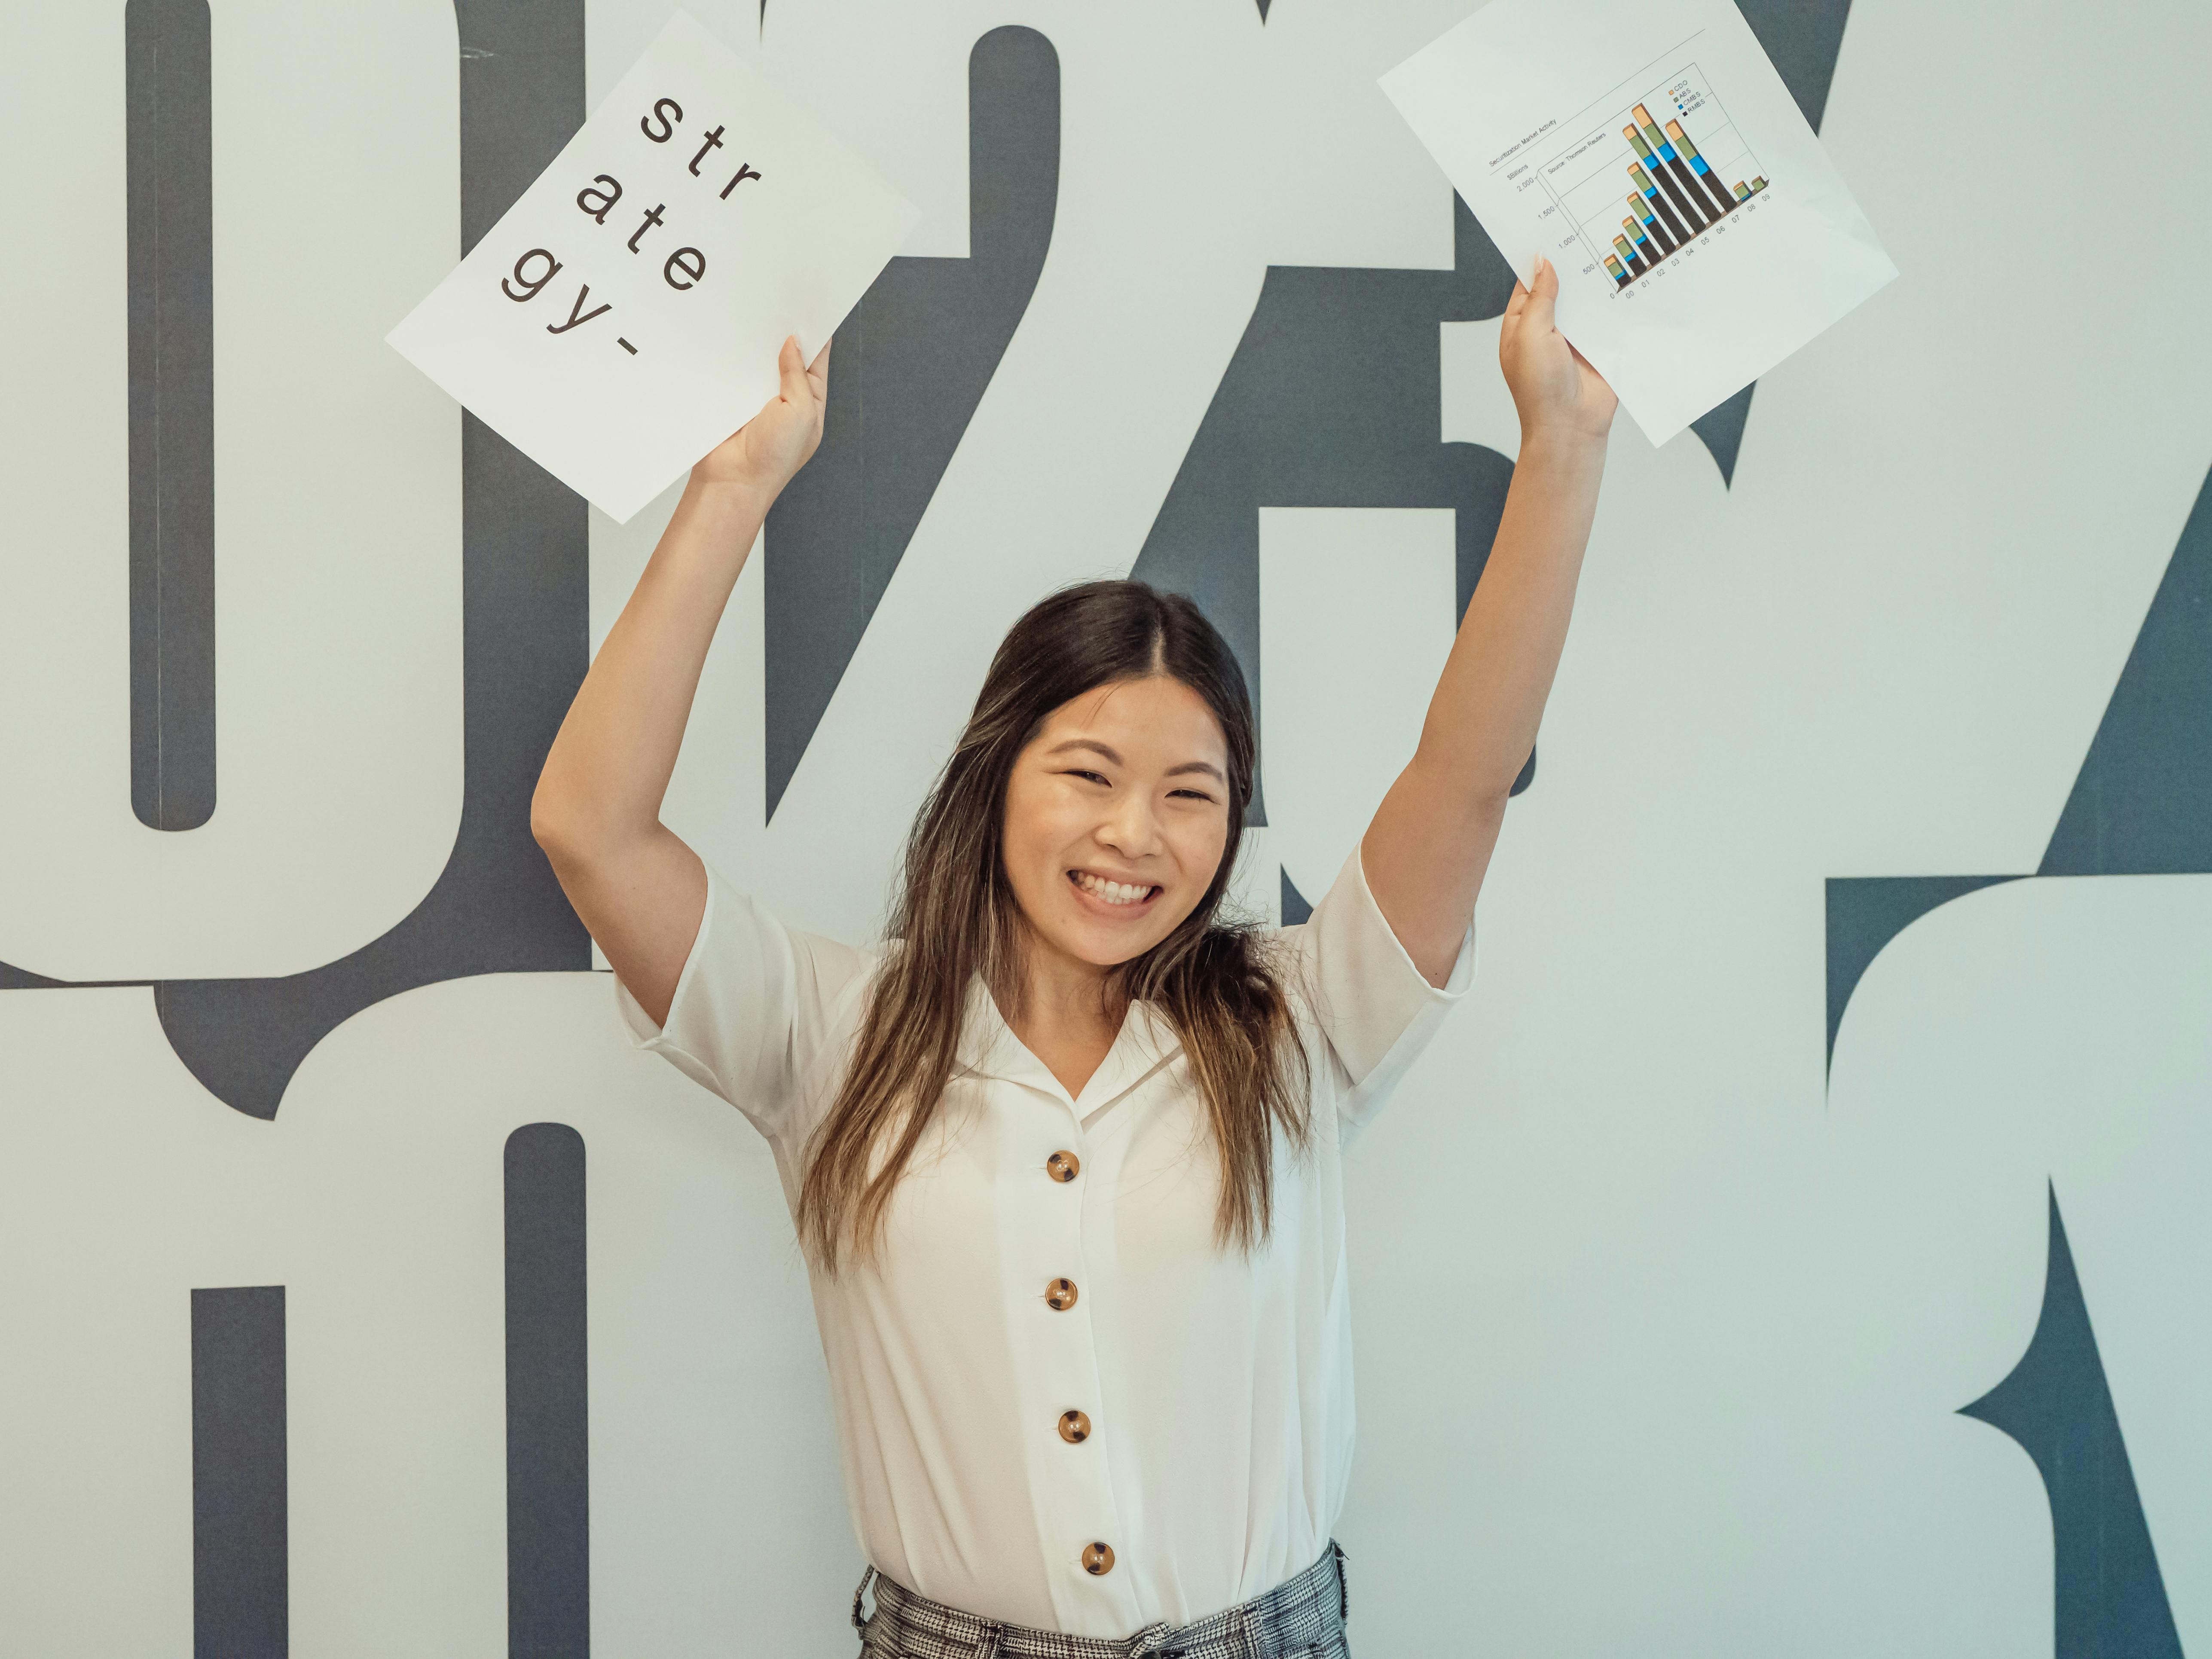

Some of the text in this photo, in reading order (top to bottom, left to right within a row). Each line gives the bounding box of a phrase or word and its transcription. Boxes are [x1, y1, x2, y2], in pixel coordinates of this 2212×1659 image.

[1674, 80, 1687, 91] CDO
[1679, 88, 1691, 99] ABS
[1683, 92, 1701, 105] CMBS
[1687, 99, 1705, 113] RMBS
[1489, 119, 1557, 167] Securitization Market Activity
[1566, 145, 1588, 162] Thomson
[1587, 132, 1606, 147] Reuters
[1507, 164, 1528, 180] $Billions
[1538, 206, 1555, 220] 1,500
[1558, 235, 1576, 249] 1,000
[1625, 194, 1771, 299] 00 01 02 03 04 05 06 07 08 09
[1583, 264, 1595, 275] 500
